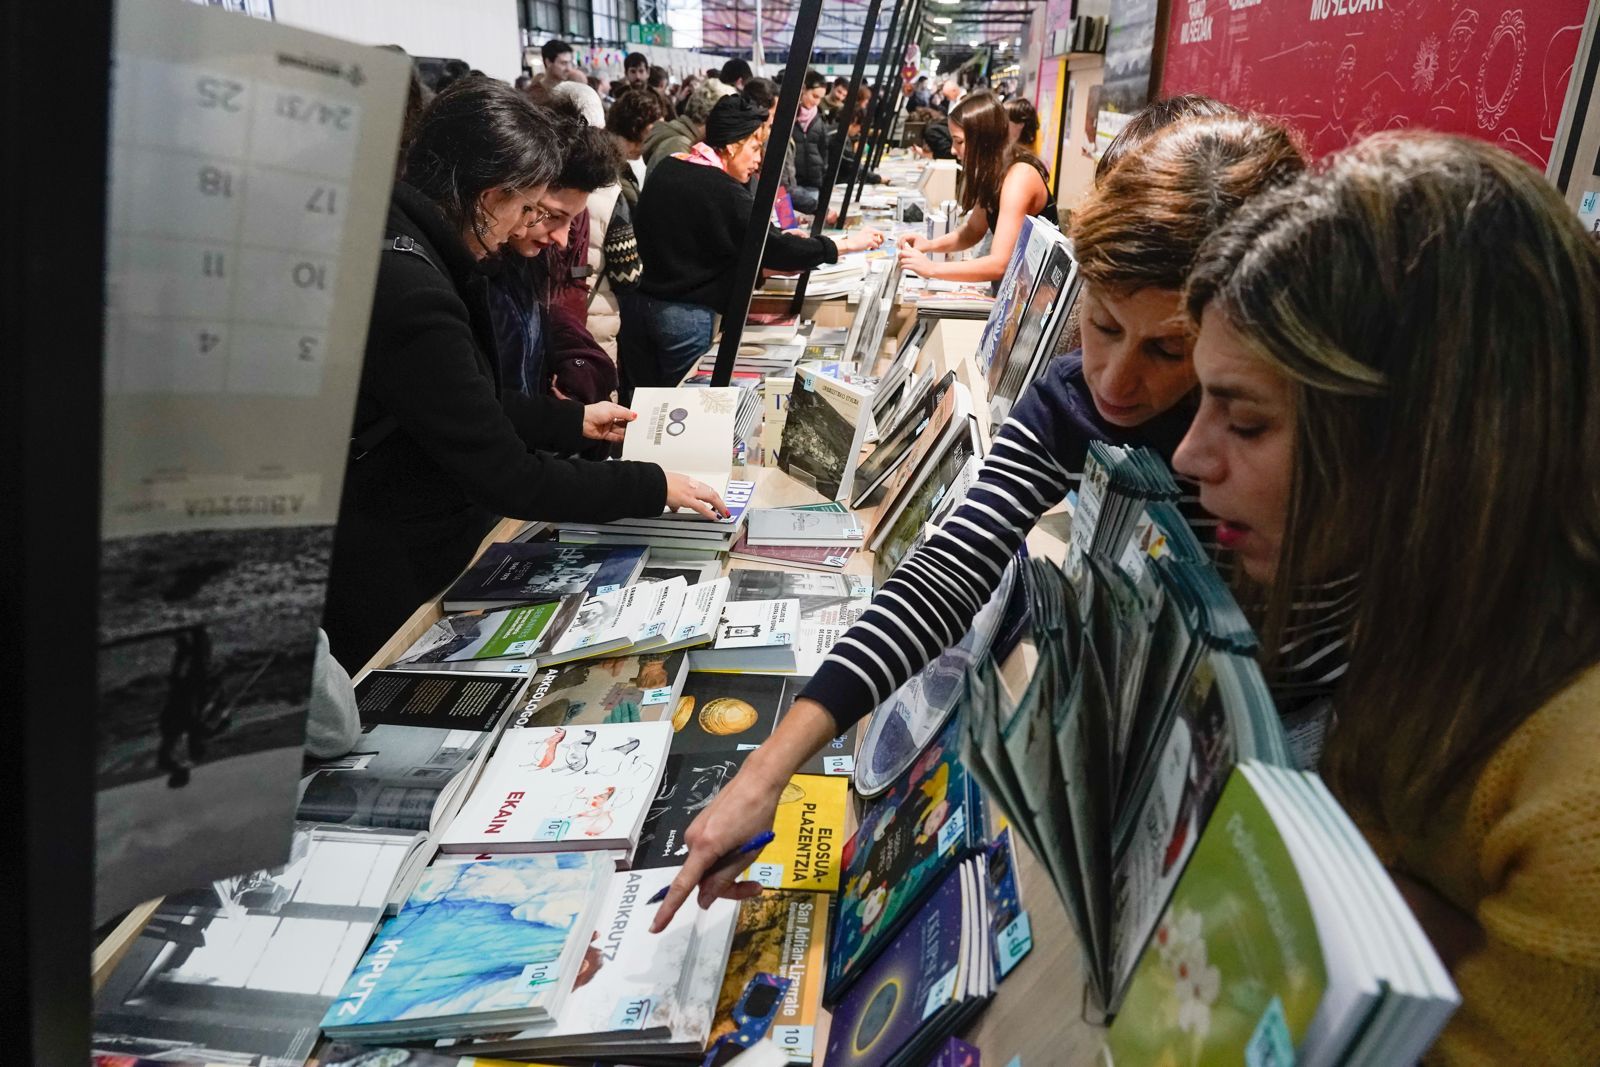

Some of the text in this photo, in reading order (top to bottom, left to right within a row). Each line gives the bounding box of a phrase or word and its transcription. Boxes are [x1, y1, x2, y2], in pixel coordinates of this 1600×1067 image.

[198, 77, 244, 113] 25
[199, 166, 232, 198] 18
[305, 187, 337, 215] 17
[203, 252, 225, 278] 11
[292, 261, 326, 290] 10
[200, 331, 221, 355] 4
[298, 335, 318, 361] 3
[484, 791, 526, 834] EKAIN
[792, 803, 817, 882] PLAZENTZIA
[602, 873, 643, 962] ARRIKRUTZ
[798, 902, 814, 923] San
[338, 939, 404, 1017] KIPUTZ
[784, 1029, 800, 1045] 10
